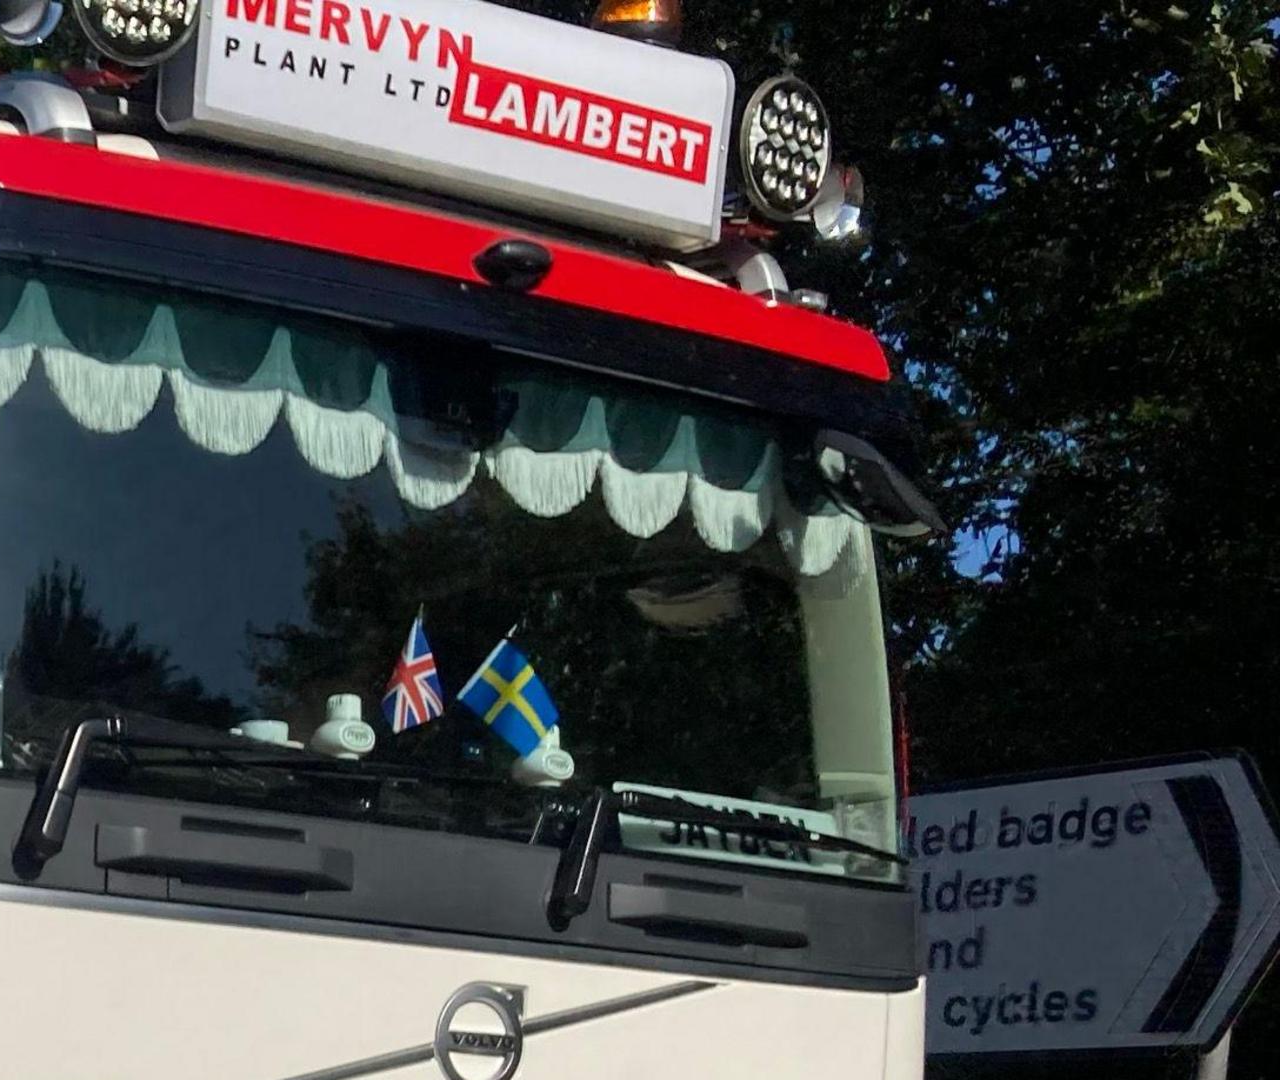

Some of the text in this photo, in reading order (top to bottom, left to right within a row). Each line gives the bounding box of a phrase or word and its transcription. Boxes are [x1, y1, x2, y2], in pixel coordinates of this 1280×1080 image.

[225, 37, 451, 107] PLANT LTD
[462, 72, 705, 172] LAMBERT
[997, 797, 1151, 850] badge
[943, 979, 1098, 1035] cycles
